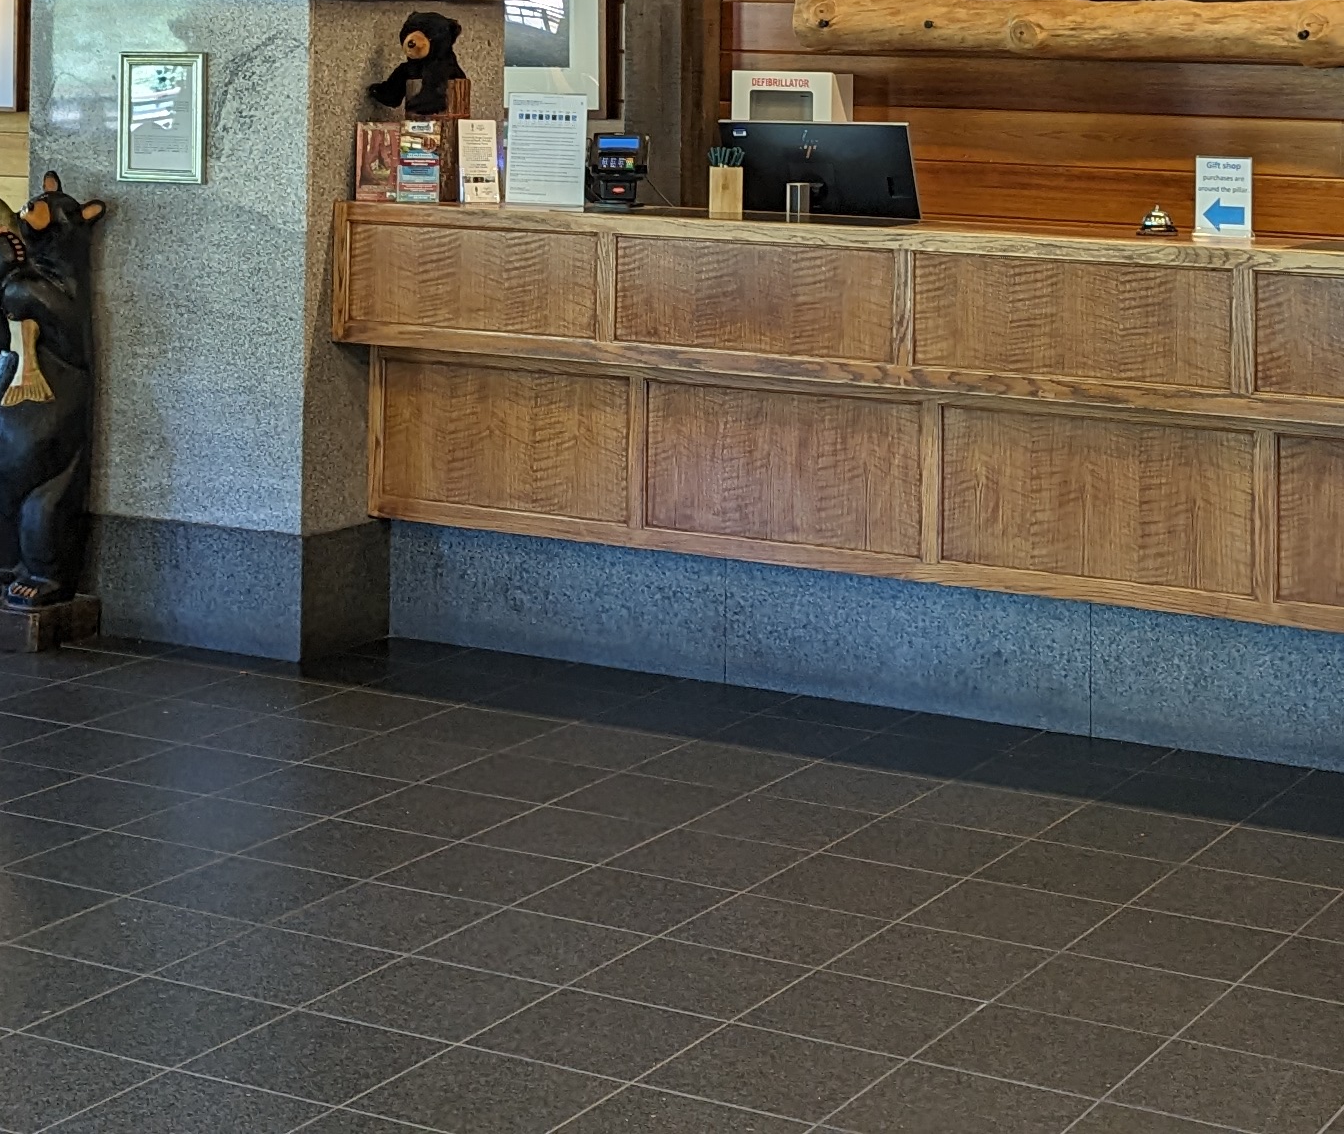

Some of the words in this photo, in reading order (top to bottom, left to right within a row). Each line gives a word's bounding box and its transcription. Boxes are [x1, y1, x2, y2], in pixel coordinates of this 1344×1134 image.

[751, 77, 810, 88] DEFIBRILLATOR
[1206, 161, 1221, 169] Gift
[1222, 162, 1241, 171] shop
